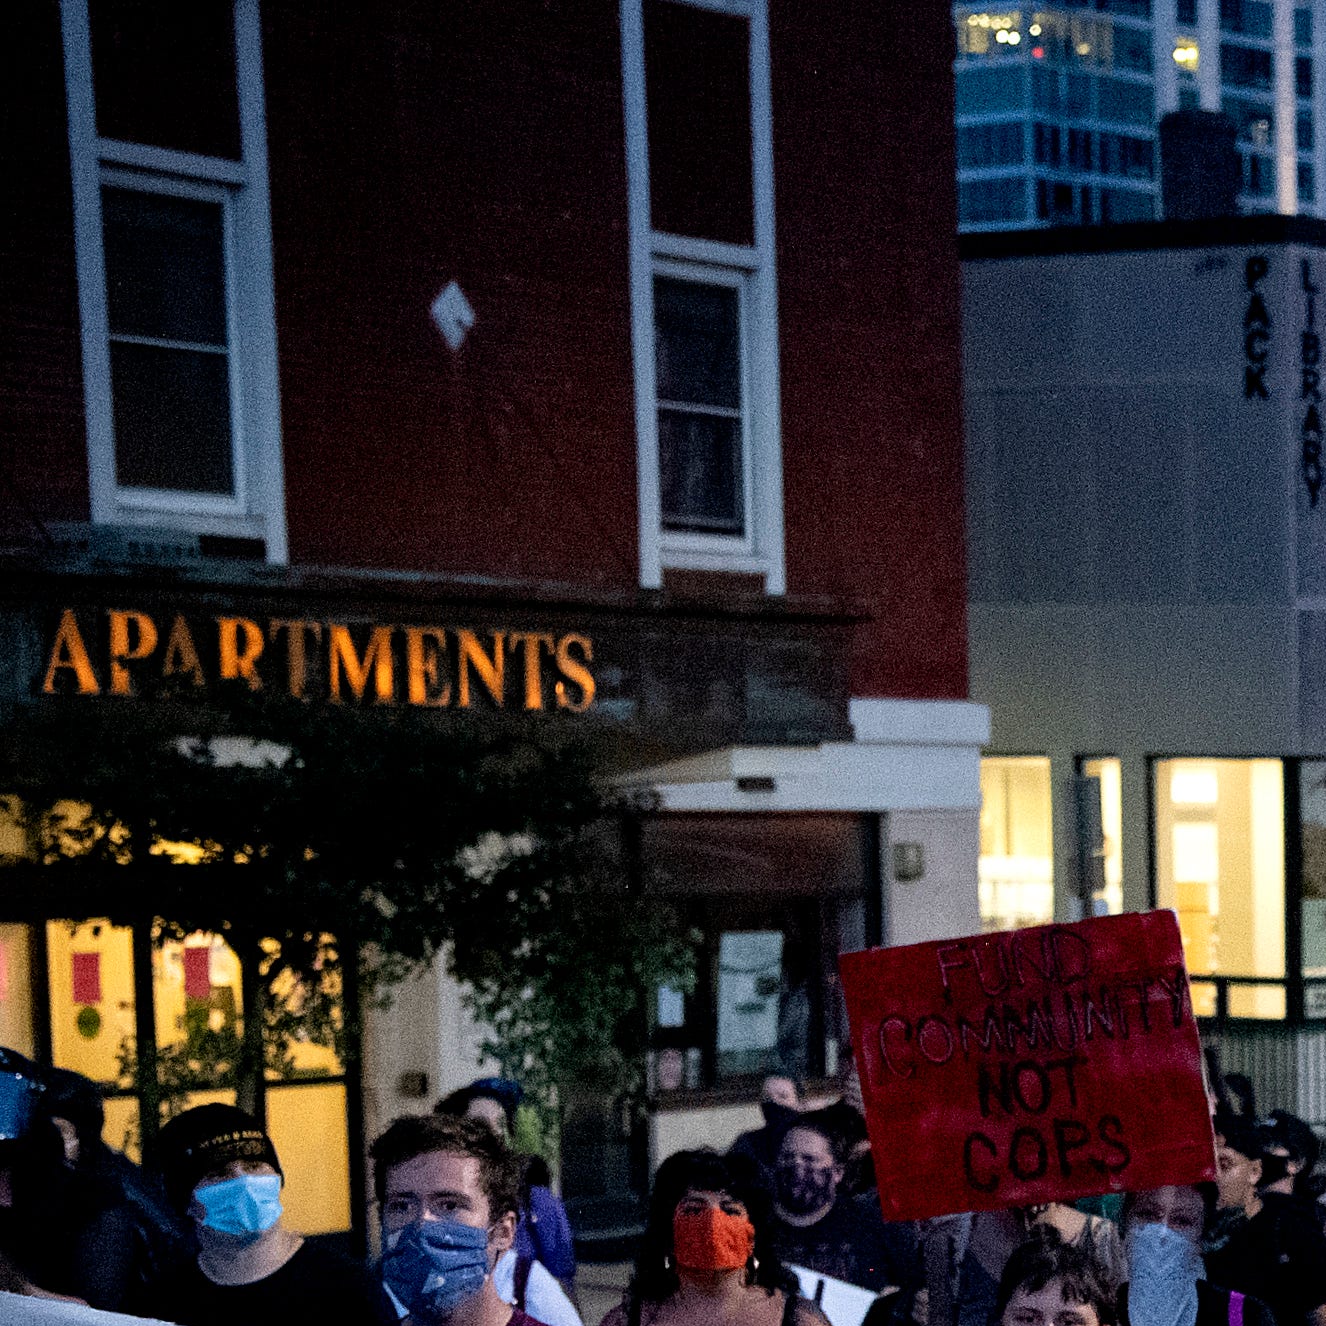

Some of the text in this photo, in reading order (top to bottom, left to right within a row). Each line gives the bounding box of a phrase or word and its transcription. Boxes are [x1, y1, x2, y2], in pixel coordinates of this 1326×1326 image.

[1245, 256, 1269, 401] PACK
[1301, 259, 1323, 508] LIBRARY
[41, 607, 597, 714] APARTMENTS
[938, 929, 1093, 1002] FUND
[879, 966, 1188, 1080] COMMUNITY
[977, 1056, 1088, 1118] NOT
[964, 1116, 1131, 1192] COPS
